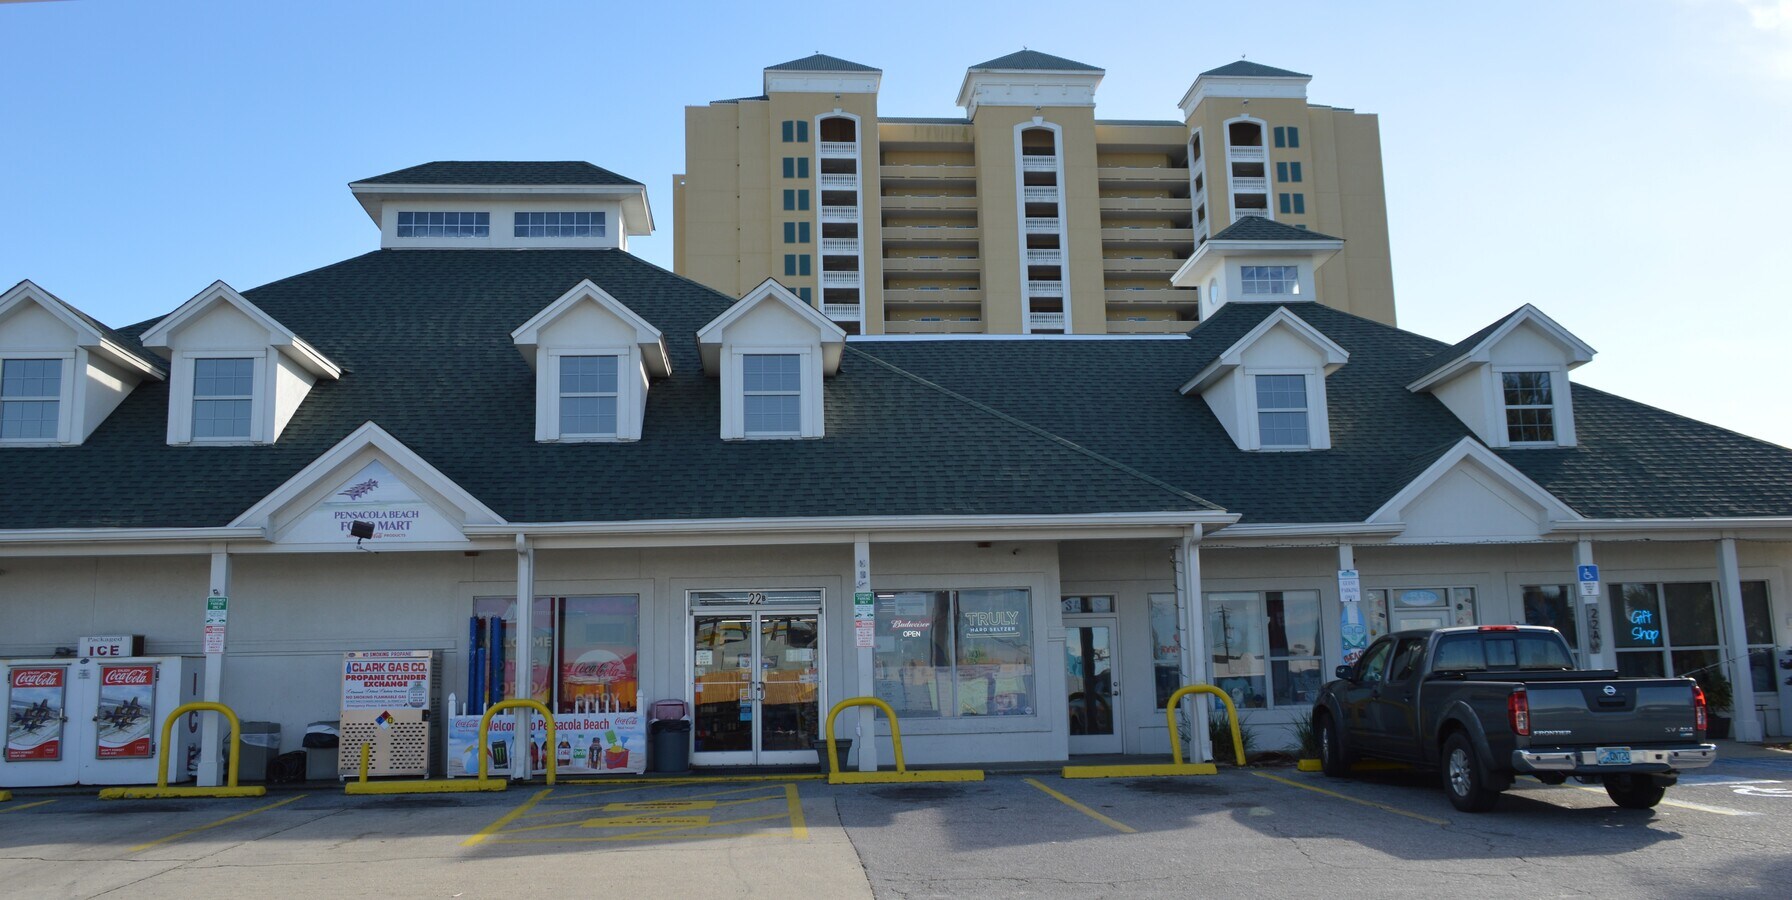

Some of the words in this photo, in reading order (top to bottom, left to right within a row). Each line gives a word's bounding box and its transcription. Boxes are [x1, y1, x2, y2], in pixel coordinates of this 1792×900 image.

[334, 511, 387, 519] PENSACOLA
[389, 510, 419, 519] BEACH
[378, 521, 412, 531] MART
[965, 611, 1018, 626] TRULY
[1630, 610, 1653, 625] Gift
[890, 619, 930, 629] Budweiser
[902, 630, 921, 638] OPEN
[1631, 626, 1659, 645] Shop
[89, 645, 119, 656] ICE
[352, 662, 386, 672] CLARK
[388, 662, 409, 672] GAS
[411, 662, 427, 672] CO.
[16, 671, 59, 686] Coca-Cola
[105, 669, 149, 684] Coca-Cola
[538, 719, 581, 731] Pesacola
[583, 718, 610, 730] Beach
